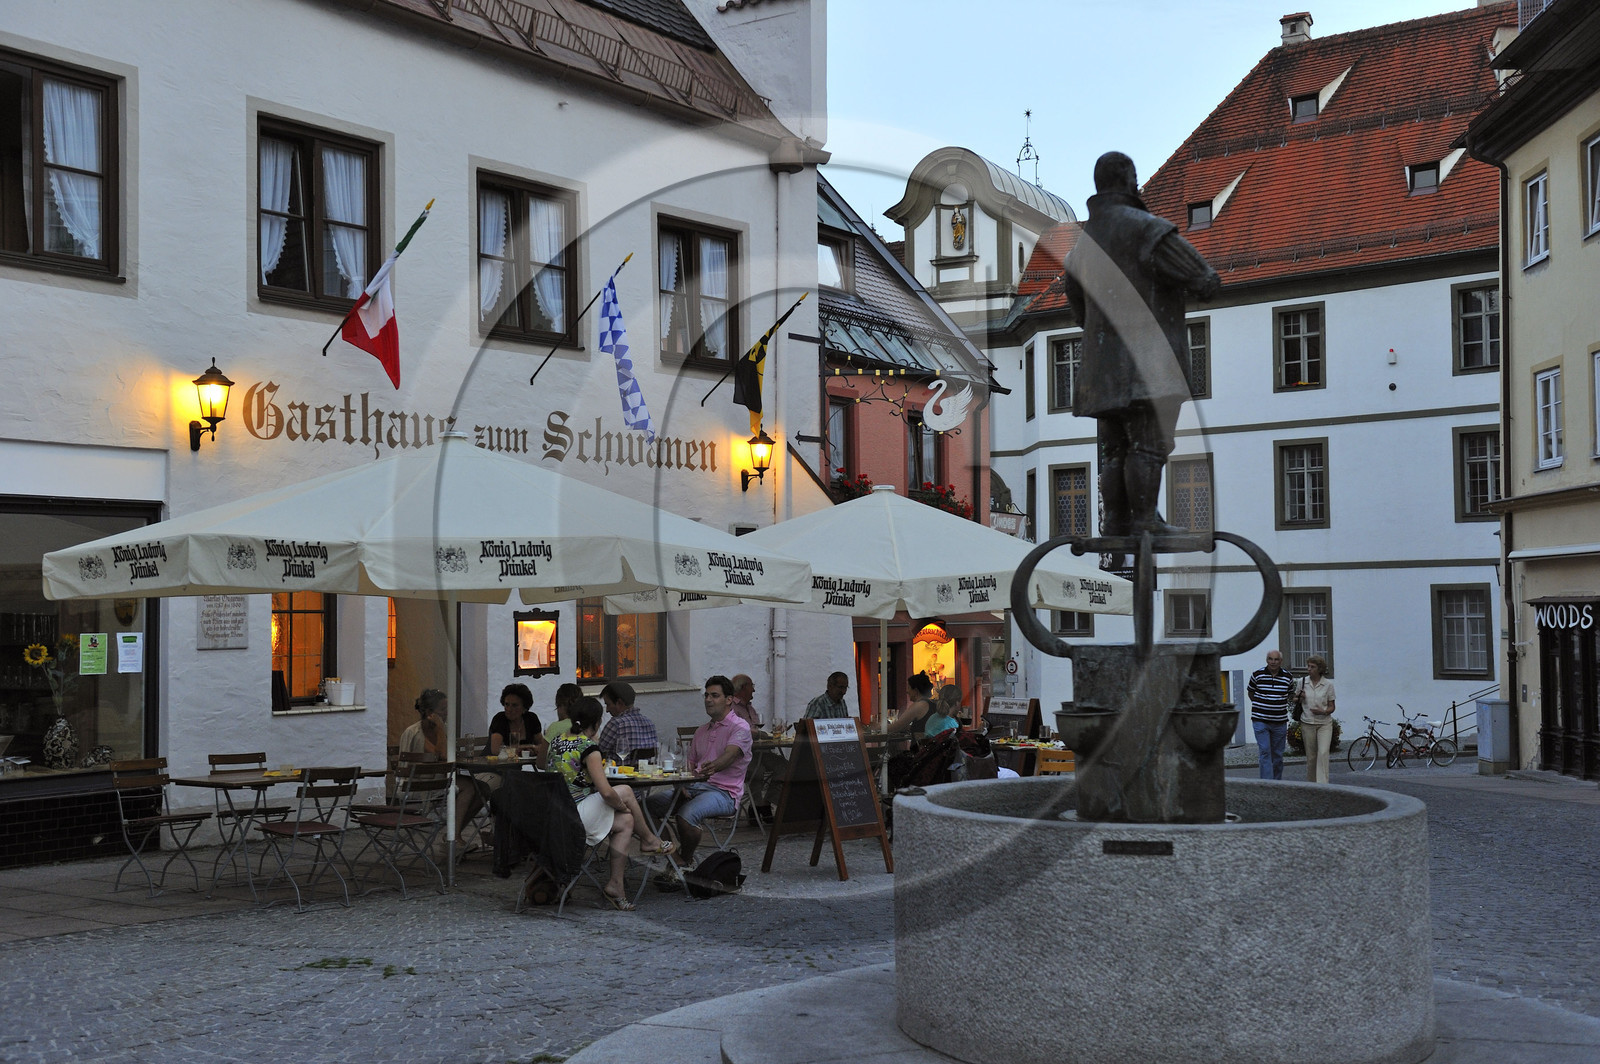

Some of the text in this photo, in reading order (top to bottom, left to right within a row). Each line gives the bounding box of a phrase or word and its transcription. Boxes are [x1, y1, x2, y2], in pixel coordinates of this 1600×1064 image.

[242, 380, 718, 476] Gasthaus zum Schwanen
[111, 541, 168, 568] König Ludwig
[264, 539, 328, 565] König Ludwig
[479, 540, 552, 563] König Ludwig
[129, 561, 160, 586] Dunkel
[282, 559, 316, 583] Dunkel
[498, 559, 537, 583] Dunkel
[707, 552, 764, 576] König Ludwig
[724, 569, 755, 589] Dunkel
[812, 575, 871, 598] König Ludwig
[822, 591, 856, 609] Dunkel
[1534, 604, 1593, 629] WOODS
